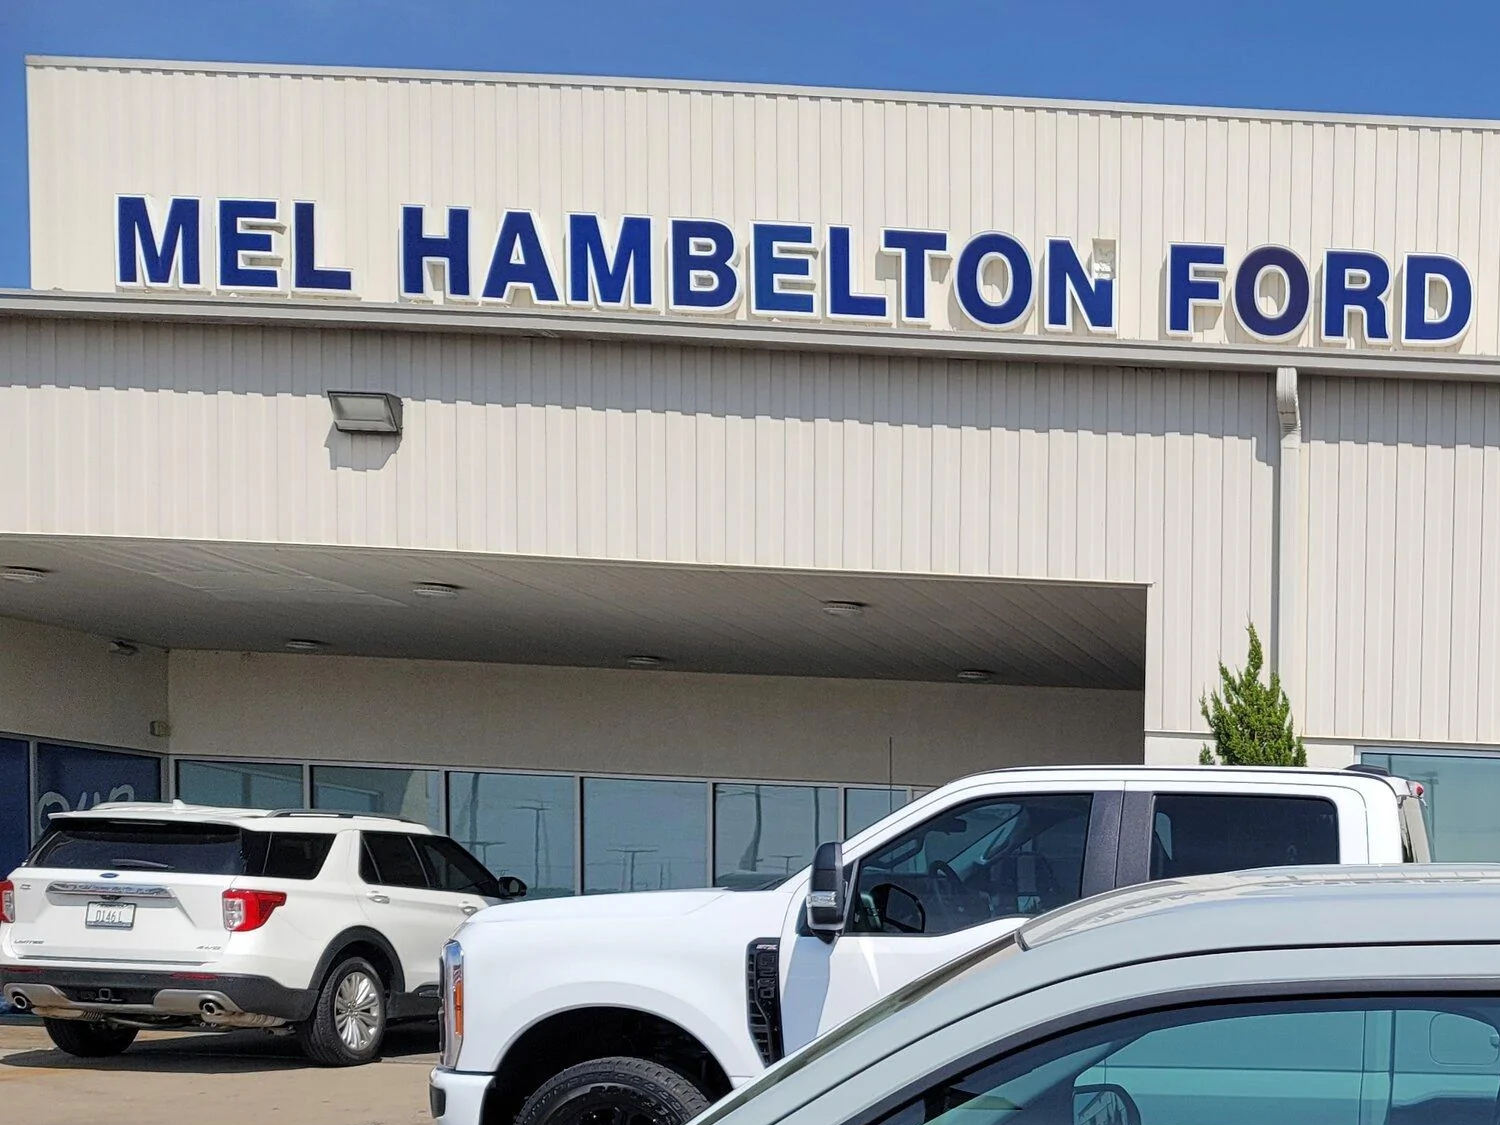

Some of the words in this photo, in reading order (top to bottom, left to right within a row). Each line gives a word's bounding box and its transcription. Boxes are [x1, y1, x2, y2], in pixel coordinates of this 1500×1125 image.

[115, 194, 354, 292] MEL
[400, 204, 1117, 332] HAMBELTON
[1167, 242, 1474, 344] FORD
